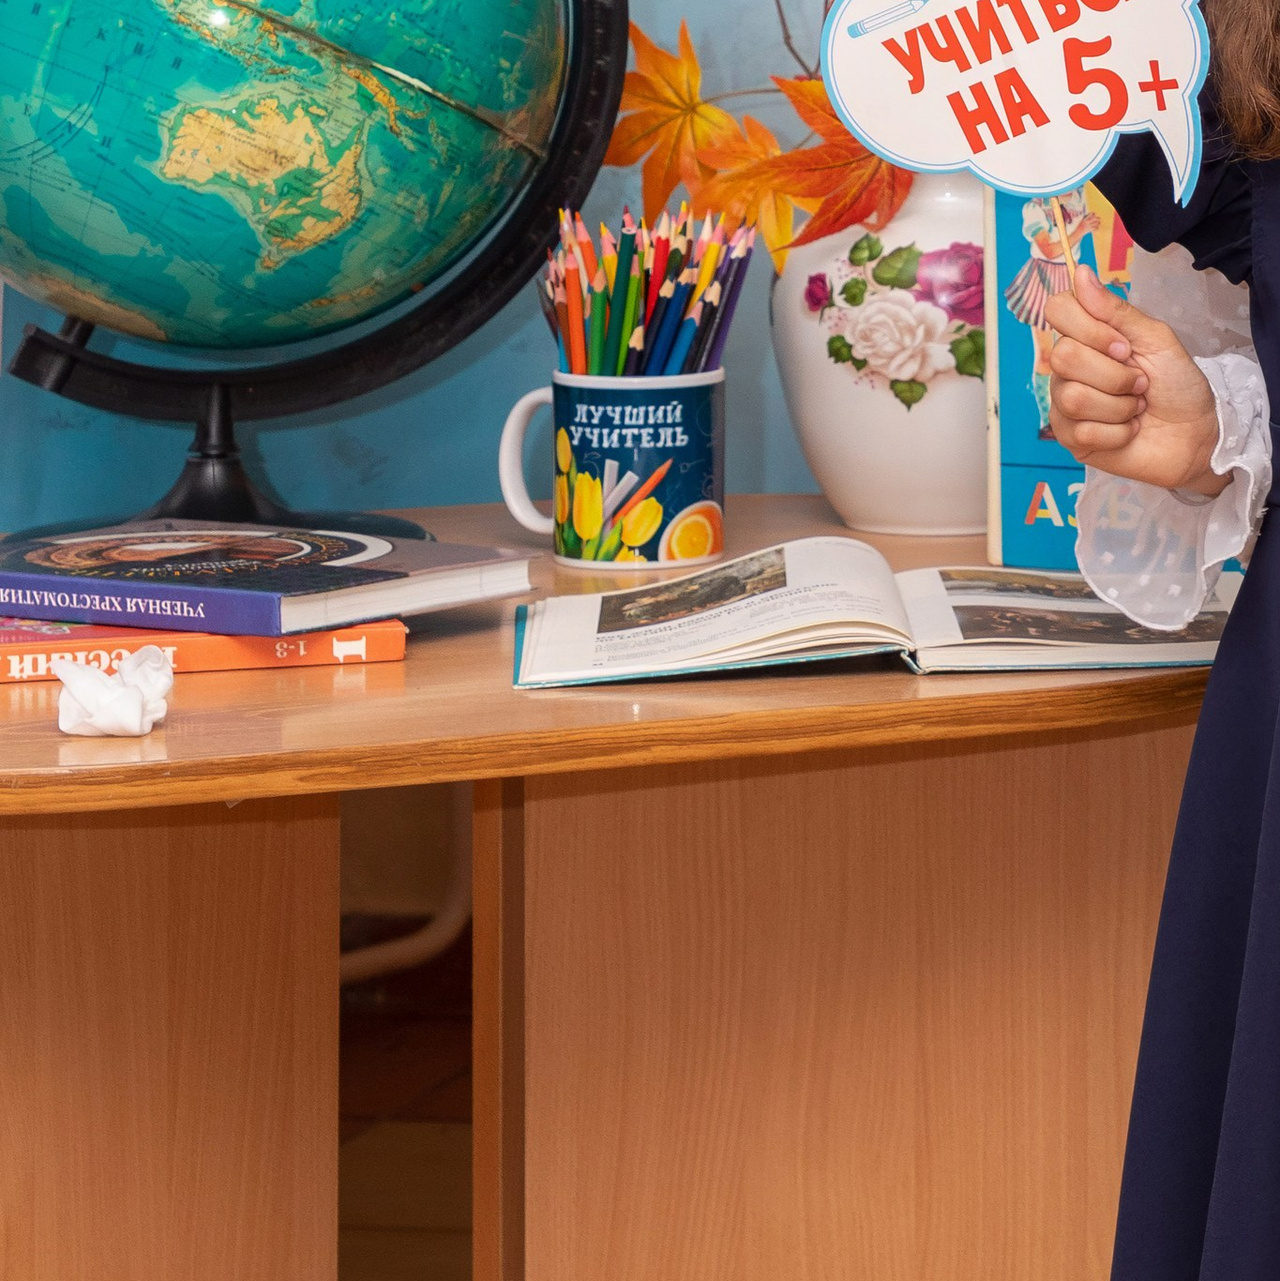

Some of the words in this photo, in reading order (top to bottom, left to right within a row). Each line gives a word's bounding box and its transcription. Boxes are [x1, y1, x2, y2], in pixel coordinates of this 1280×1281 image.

[946, 67, 1051, 155] НА
[1063, 36, 1179, 131] 5+
[574, 401, 683, 425] ЛУЧШИЙ
[570, 426, 689, 449] УЧИТЕЛЬ
[0, 588, 123, 612] ХРЕСТОМАТИЯ
[126, 597, 205, 618] УЧЕБНАЯ
[275, 641, 307, 658] 1-3
